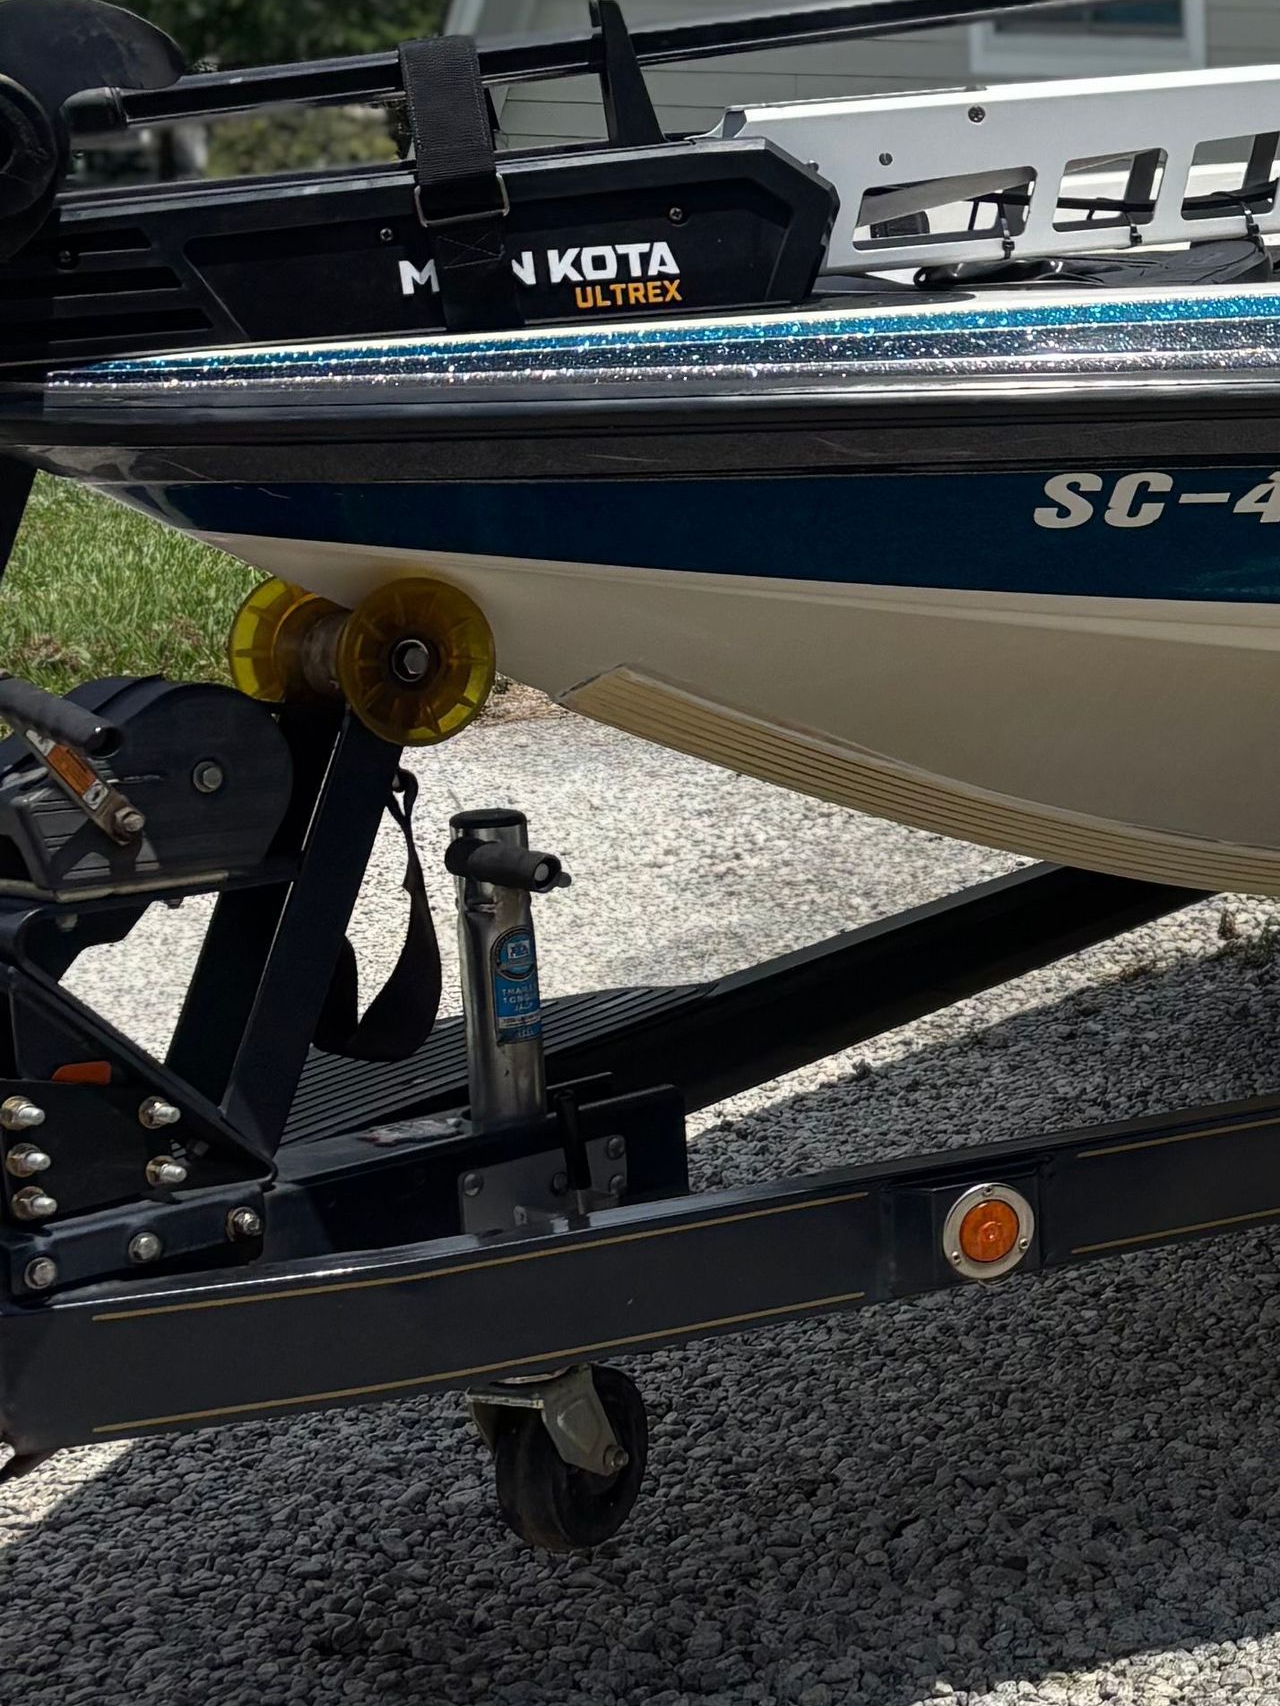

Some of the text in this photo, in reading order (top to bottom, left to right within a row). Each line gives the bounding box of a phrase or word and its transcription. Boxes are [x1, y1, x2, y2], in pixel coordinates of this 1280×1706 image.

[399, 241, 680, 295] MN KOTA
[575, 279, 683, 309] ULTREX
